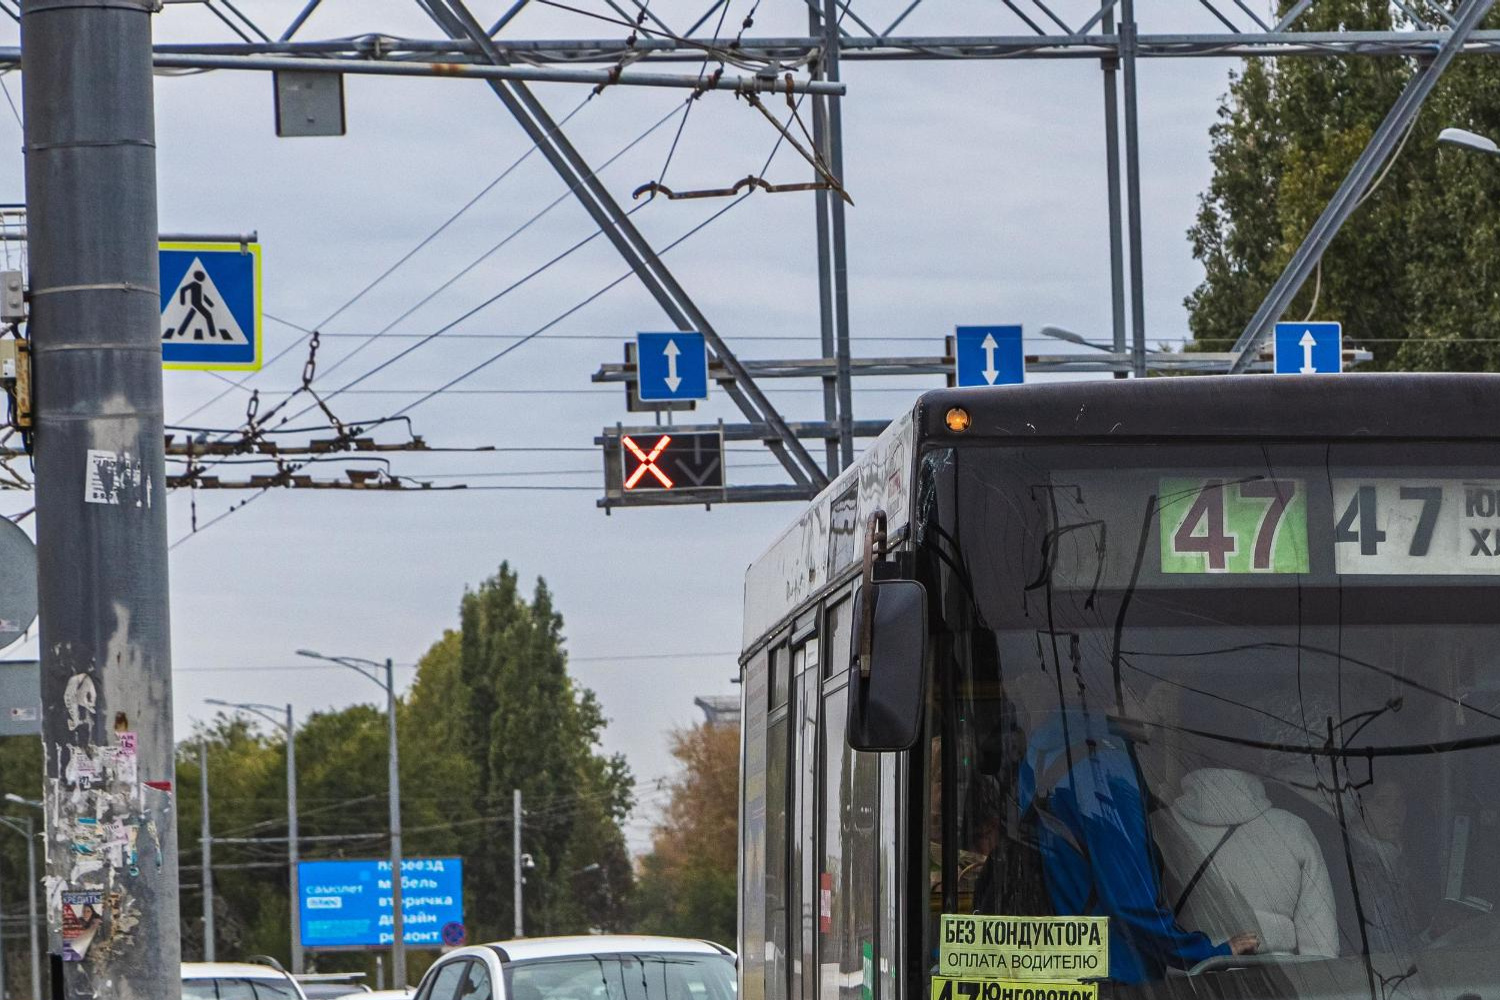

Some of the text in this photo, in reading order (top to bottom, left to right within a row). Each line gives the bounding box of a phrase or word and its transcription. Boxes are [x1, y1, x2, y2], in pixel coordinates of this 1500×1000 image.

[1172, 478, 1297, 571] 47
[1335, 485, 1442, 557] 47
[378, 876, 438, 889] мбель
[379, 896, 453, 909] втричка
[945, 919, 1101, 949] БЕЗ КОНДУКТОРА
[948, 952, 1099, 971] ОПЛАТА ВОДИТЕЛЮ
